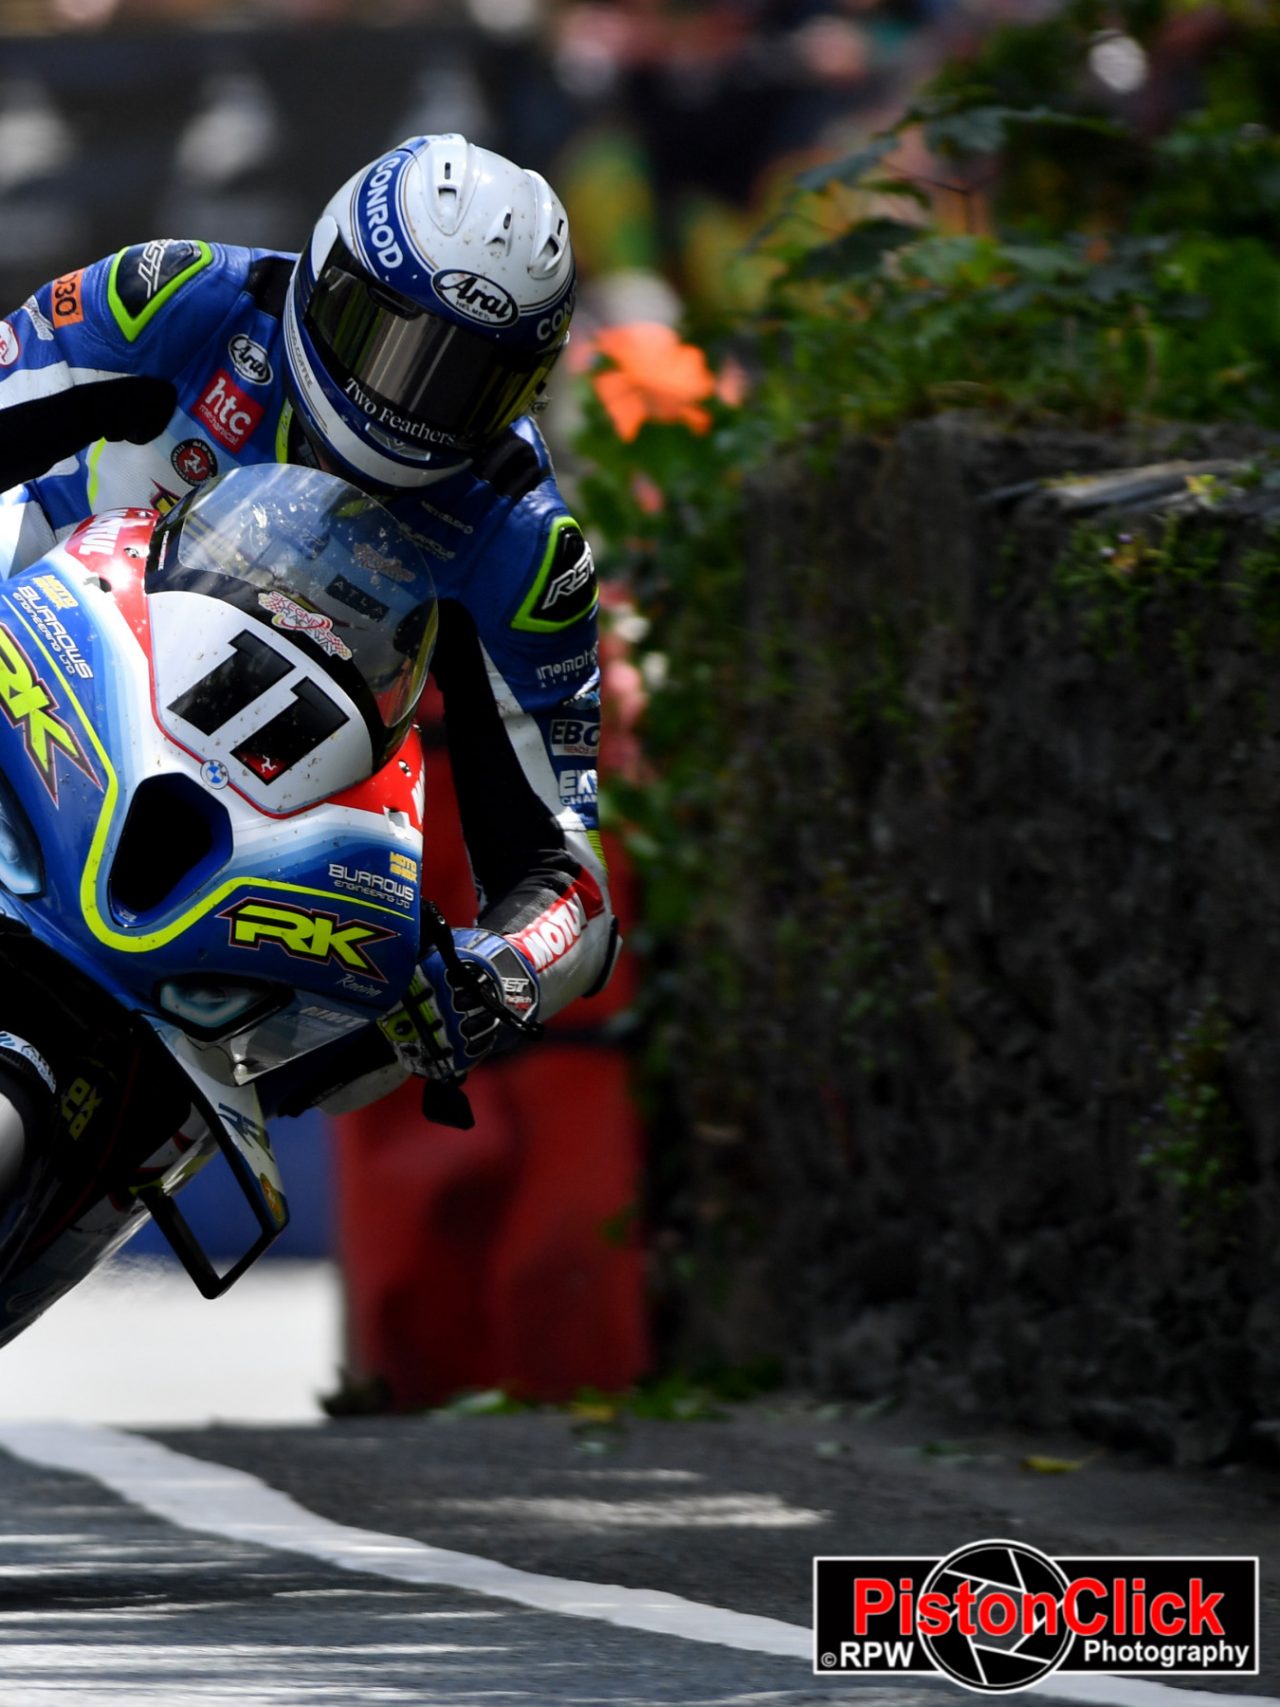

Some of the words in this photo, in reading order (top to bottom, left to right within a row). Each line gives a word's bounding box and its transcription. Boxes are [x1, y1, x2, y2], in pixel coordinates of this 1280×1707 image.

[366, 157, 404, 269] CONROD
[437, 276, 510, 318] Arai
[536, 296, 574, 342] CON
[232, 342, 267, 378] Arai
[205, 377, 252, 436] htc
[378, 407, 458, 445] Feathers
[17, 585, 95, 679] BURROWS
[166, 629, 351, 786] 11
[328, 863, 415, 902] BURROWS
[227, 900, 388, 976] RK
